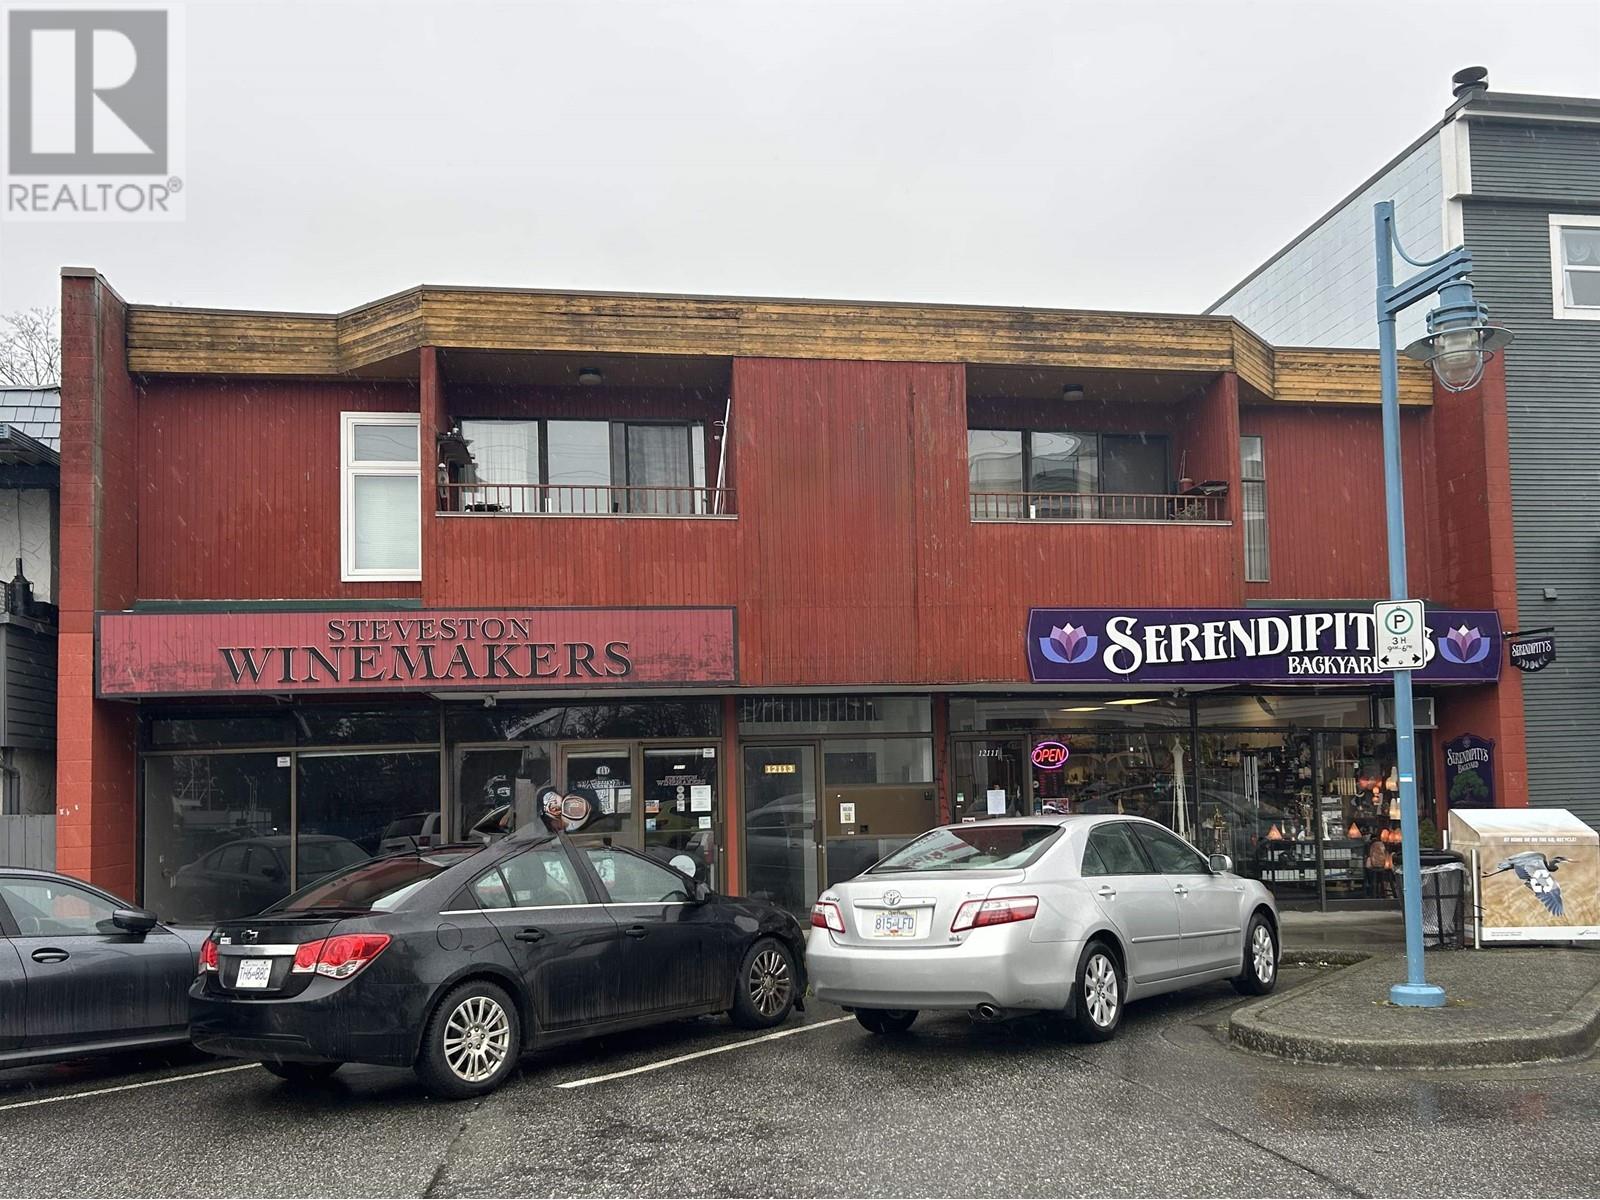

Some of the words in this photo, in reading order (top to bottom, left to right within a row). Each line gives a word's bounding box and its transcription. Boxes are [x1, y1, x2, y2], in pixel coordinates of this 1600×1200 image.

[327, 616, 532, 642] STEVESTON
[1394, 614, 1405, 629] P
[1392, 637, 1399, 645] 3
[1400, 636, 1407, 644] H
[218, 640, 635, 684] WINEMAKERS
[1033, 748, 1066, 763] OPEN
[766, 765, 794, 773] 12113
